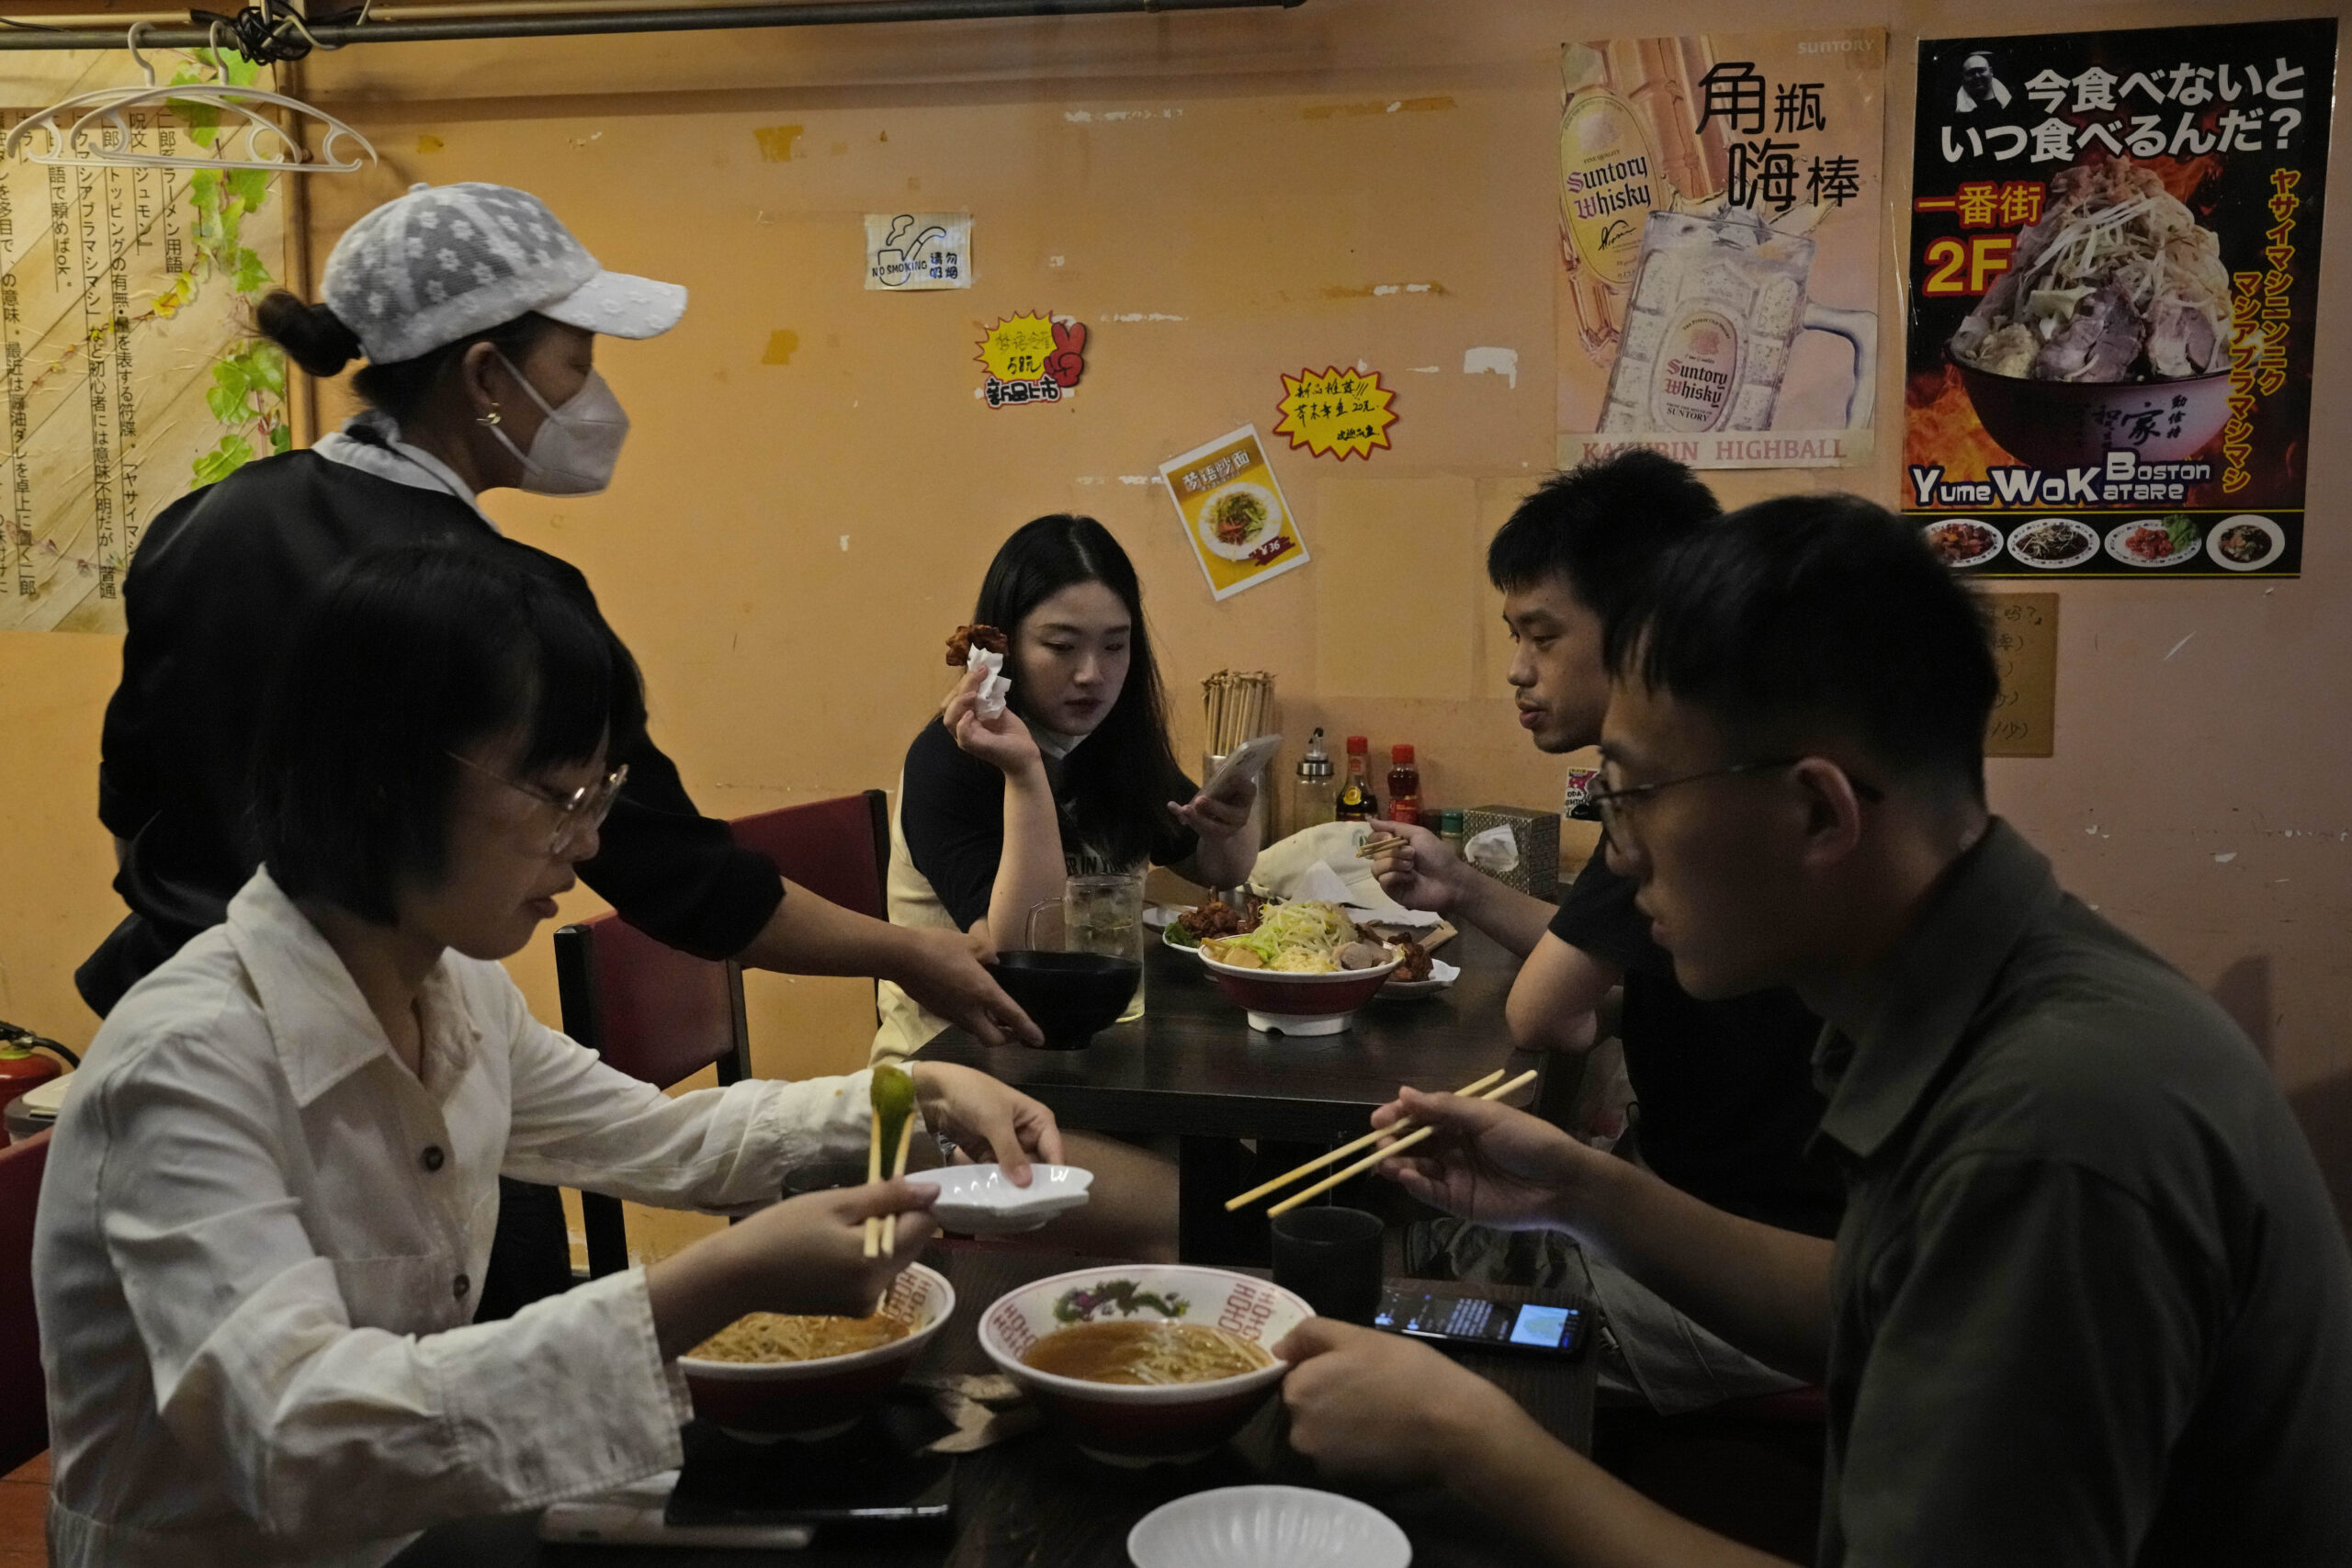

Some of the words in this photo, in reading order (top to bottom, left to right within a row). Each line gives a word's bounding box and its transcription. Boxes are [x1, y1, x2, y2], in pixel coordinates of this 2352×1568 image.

[1798, 39, 1875, 56] SUNTORY
[1695, 62, 1826, 135] 角瓶
[2024, 57, 2304, 113] 今食べないと
[1941, 107, 2302, 164] いつ食べるんだ？
[131, 113, 153, 247] 呪文ジュモン』
[1566, 156, 1648, 194] Suntory
[1728, 138, 1860, 211] 嗨棒
[1574, 183, 1651, 220] Whisky
[1918, 186, 2041, 224] 一番街
[872, 266, 886, 276] NO
[888, 260, 927, 275] SMOKING
[930, 252, 958, 265] 请勿
[930, 266, 958, 279] 吸烟
[1927, 238, 2012, 292] 2F
[2257, 168, 2301, 396] ヤサイマシニンニク
[987, 377, 1058, 406] 新品上市
[1667, 358, 1728, 390] Suntory
[2222, 271, 2263, 493] マシアブラマシマシ
[1665, 378, 1723, 409] Whisky
[1667, 408, 1708, 423] SUNTORY
[1716, 439, 1848, 459] HIGHBALL
[1182, 450, 1250, 491] 梦语炒面
[1912, 467, 1992, 503] Yume
